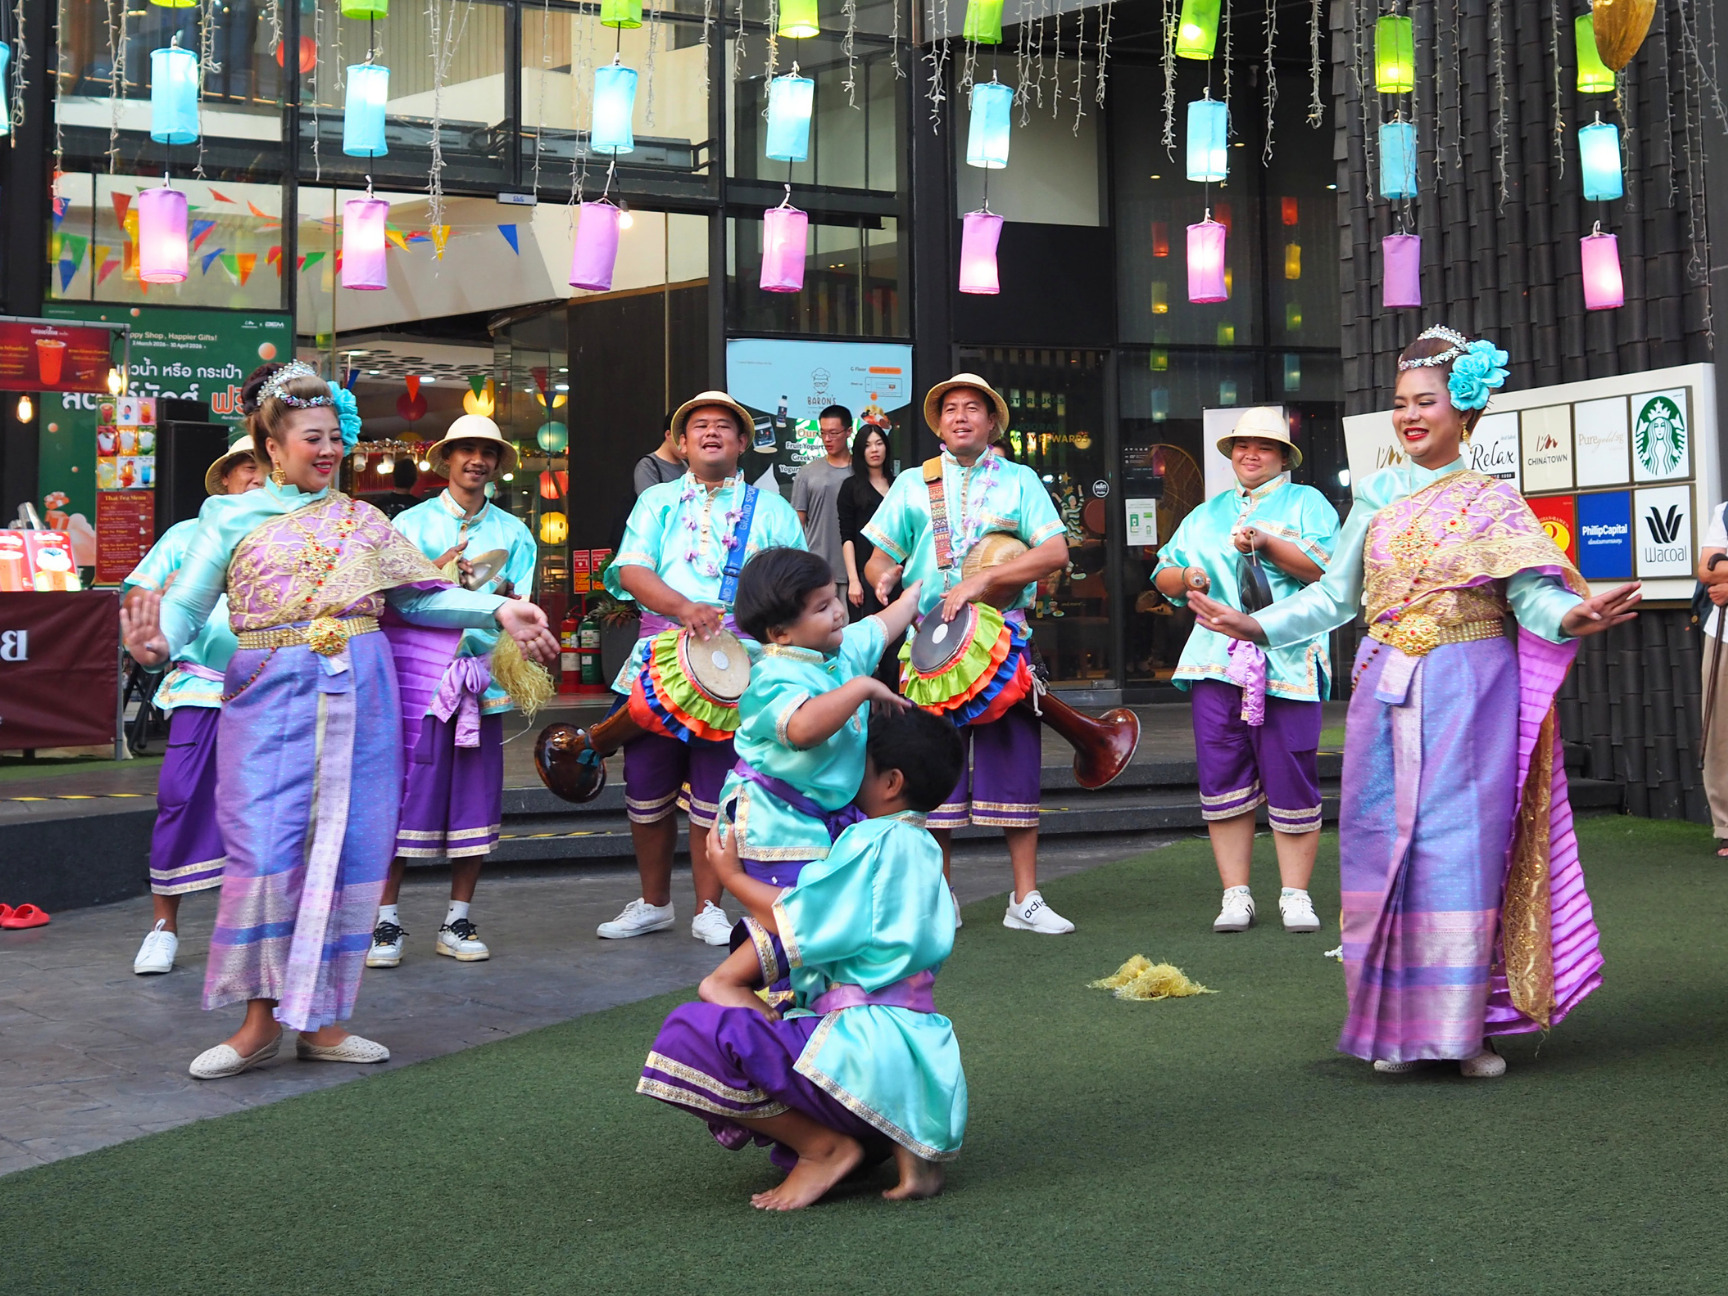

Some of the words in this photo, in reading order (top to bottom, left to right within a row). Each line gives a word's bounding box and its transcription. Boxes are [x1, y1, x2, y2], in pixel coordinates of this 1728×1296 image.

[168, 333, 196, 342] Happier
[117, 356, 157, 377] แวน้ำ
[162, 362, 191, 377] หรือ
[1010, 397, 1065, 405] STRUCS
[797, 428, 818, 438] Our
[1038, 433, 1088, 443] REWARDS
[803, 442, 825, 452] Yogurt
[791, 453, 810, 462] Greek
[1470, 440, 1516, 473] Relax
[1527, 454, 1568, 466] CHINATOWN
[745, 484, 757, 503] SPOR
[1582, 523, 1628, 537] PhillipCapital
[1645, 545, 1687, 562] Wacoal
